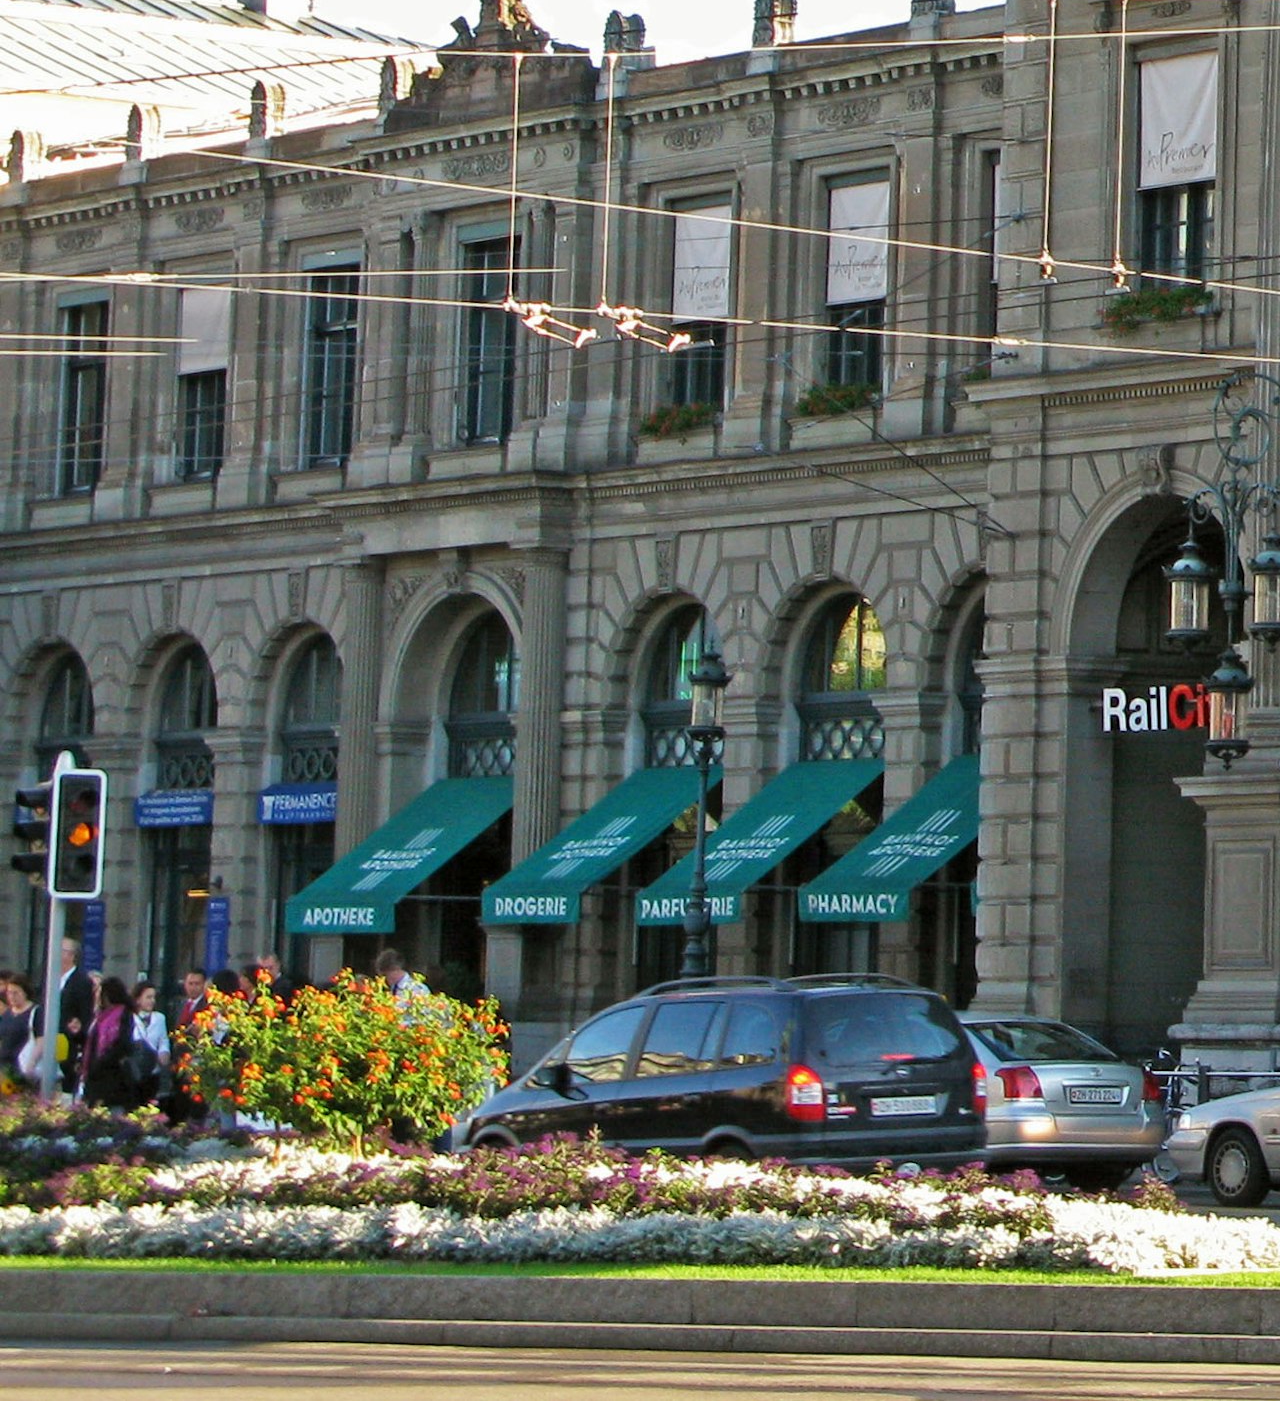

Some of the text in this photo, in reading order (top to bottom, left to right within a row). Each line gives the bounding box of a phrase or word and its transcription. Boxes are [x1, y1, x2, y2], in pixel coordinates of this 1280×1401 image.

[1103, 683, 1211, 731] RailCi
[717, 837, 790, 850] BAHNHOF
[881, 834, 960, 846] BAHNHOF
[704, 849, 777, 861] APOTHEKE
[867, 845, 946, 857] APOTHEKE
[495, 896, 568, 916] DROGERIE
[641, 896, 735, 918] PARFURIE
[808, 894, 898, 914] PHARMACY
[302, 907, 376, 926] APOTHEKE
